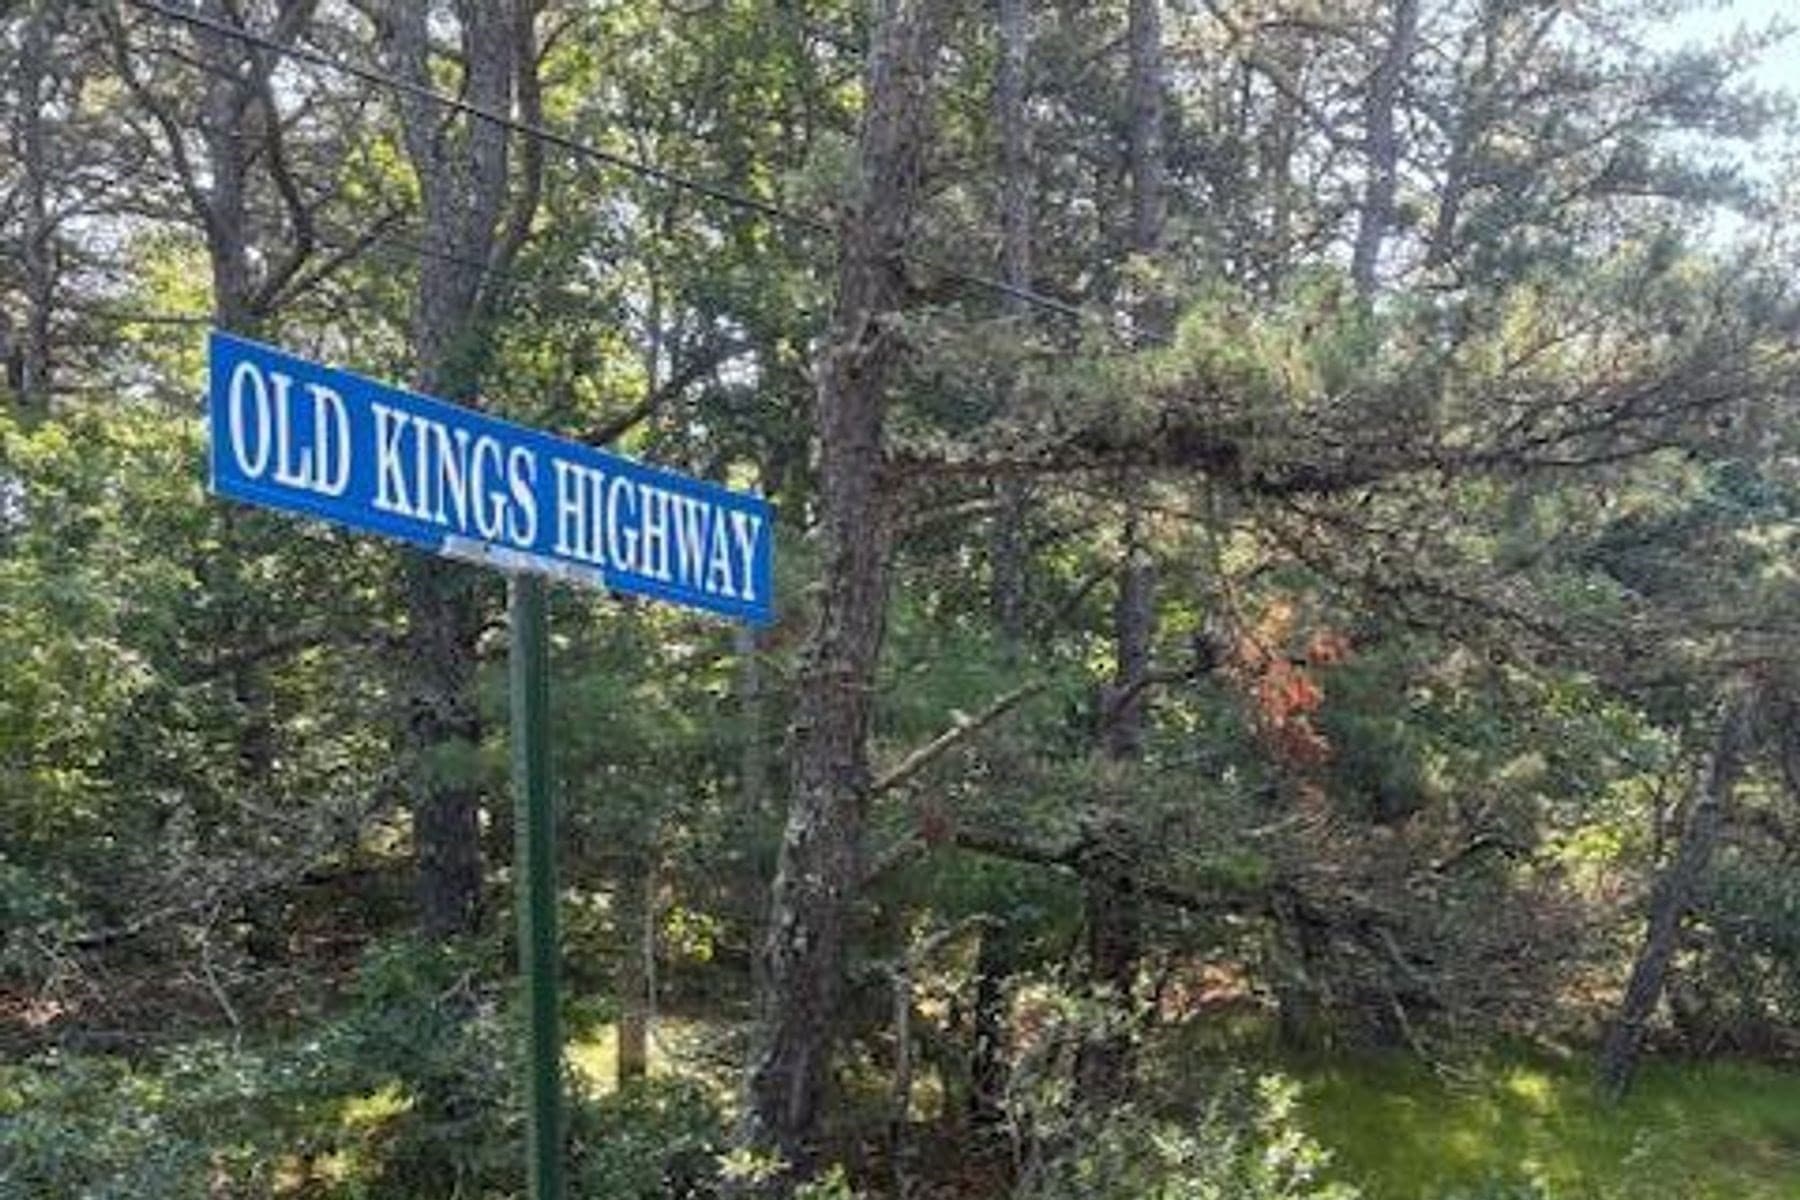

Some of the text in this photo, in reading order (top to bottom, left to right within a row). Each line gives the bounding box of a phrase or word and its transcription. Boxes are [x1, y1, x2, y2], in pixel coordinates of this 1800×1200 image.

[228, 360, 762, 601] OLD KINGS HIGHWAY
